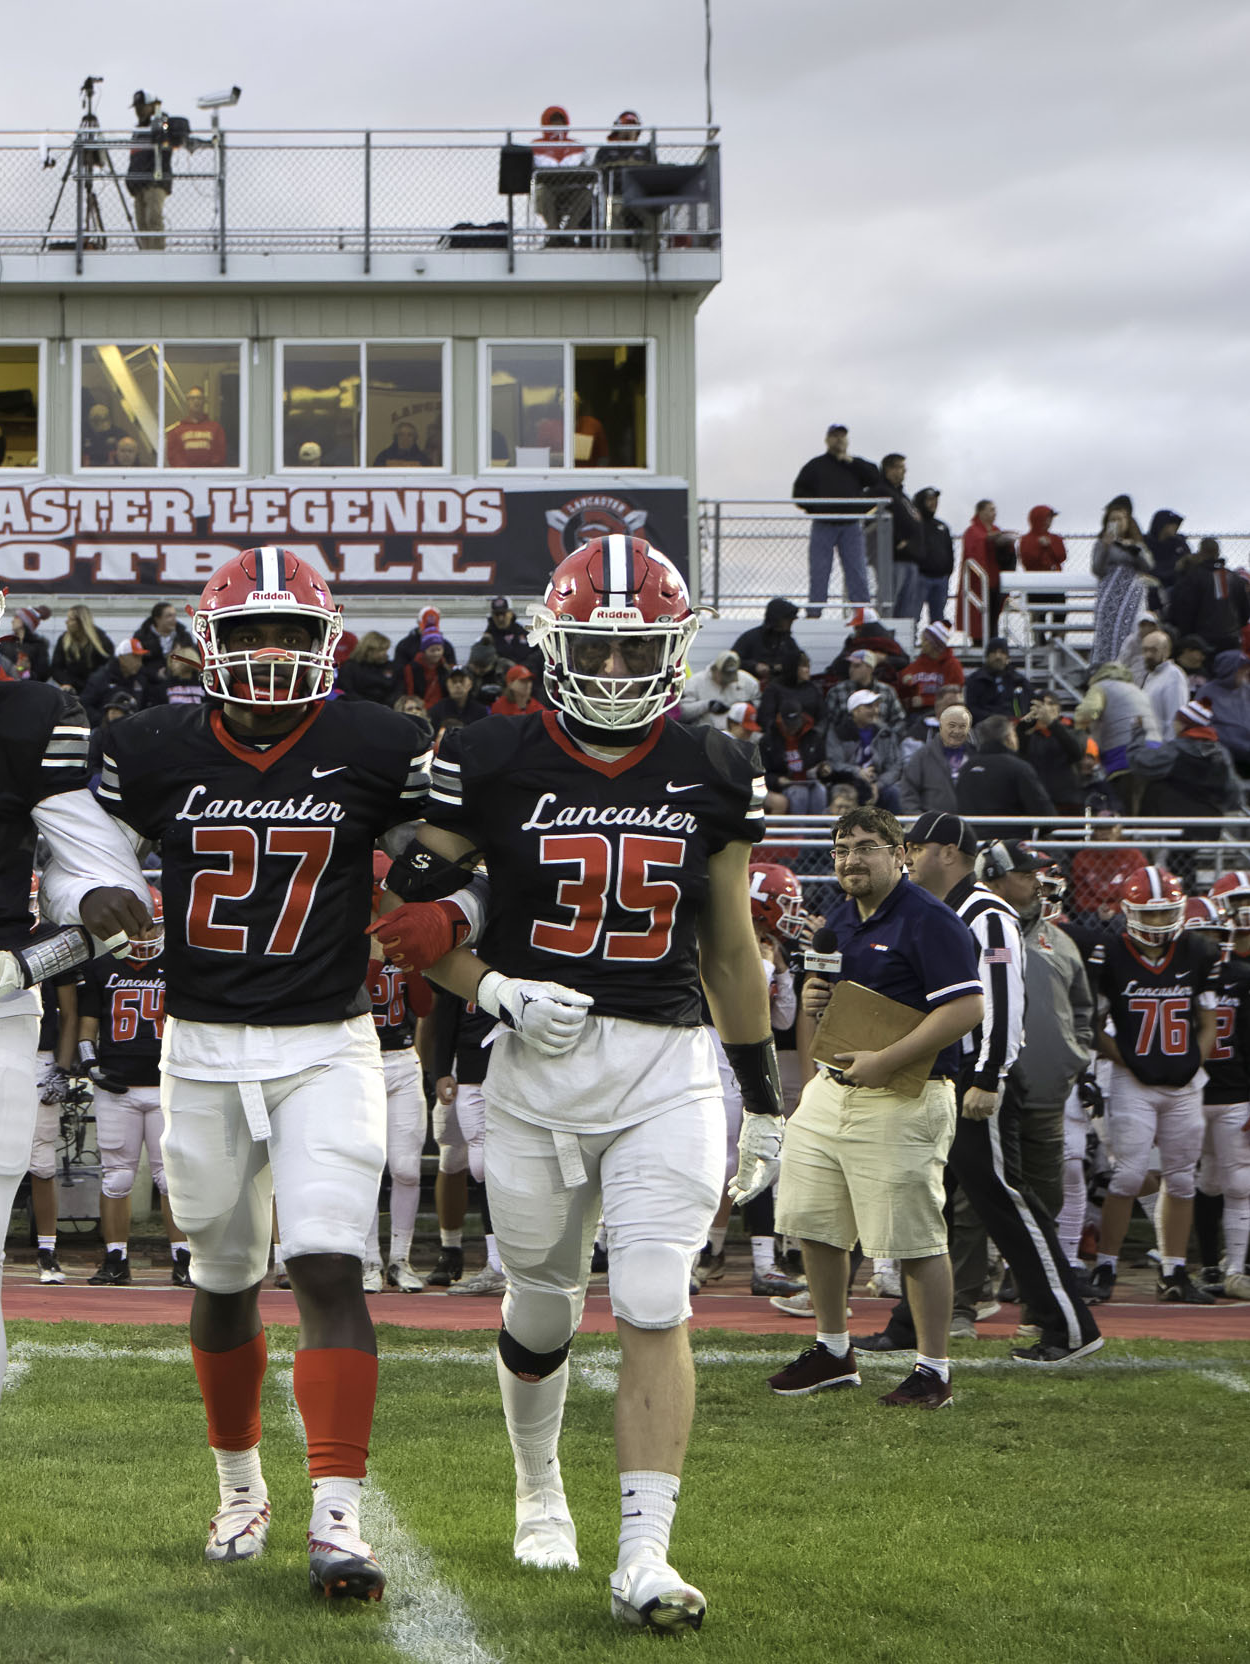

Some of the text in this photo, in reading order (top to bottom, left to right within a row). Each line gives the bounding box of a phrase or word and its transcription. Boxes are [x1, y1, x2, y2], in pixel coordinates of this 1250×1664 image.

[208, 487, 507, 536] LEGENDS
[566, 496, 627, 513] LANCASTER
[252, 592, 292, 601] Riddell
[596, 610, 637, 620] Riddell
[175, 784, 346, 822] Lancaster
[521, 792, 698, 834] Lancaster
[185, 825, 336, 956] 27
[530, 832, 687, 962] 35
[104, 973, 166, 989] Lancaste
[1120, 979, 1194, 998] Lancaster
[111, 988, 166, 1042] 64
[1128, 997, 1191, 1057] 76
